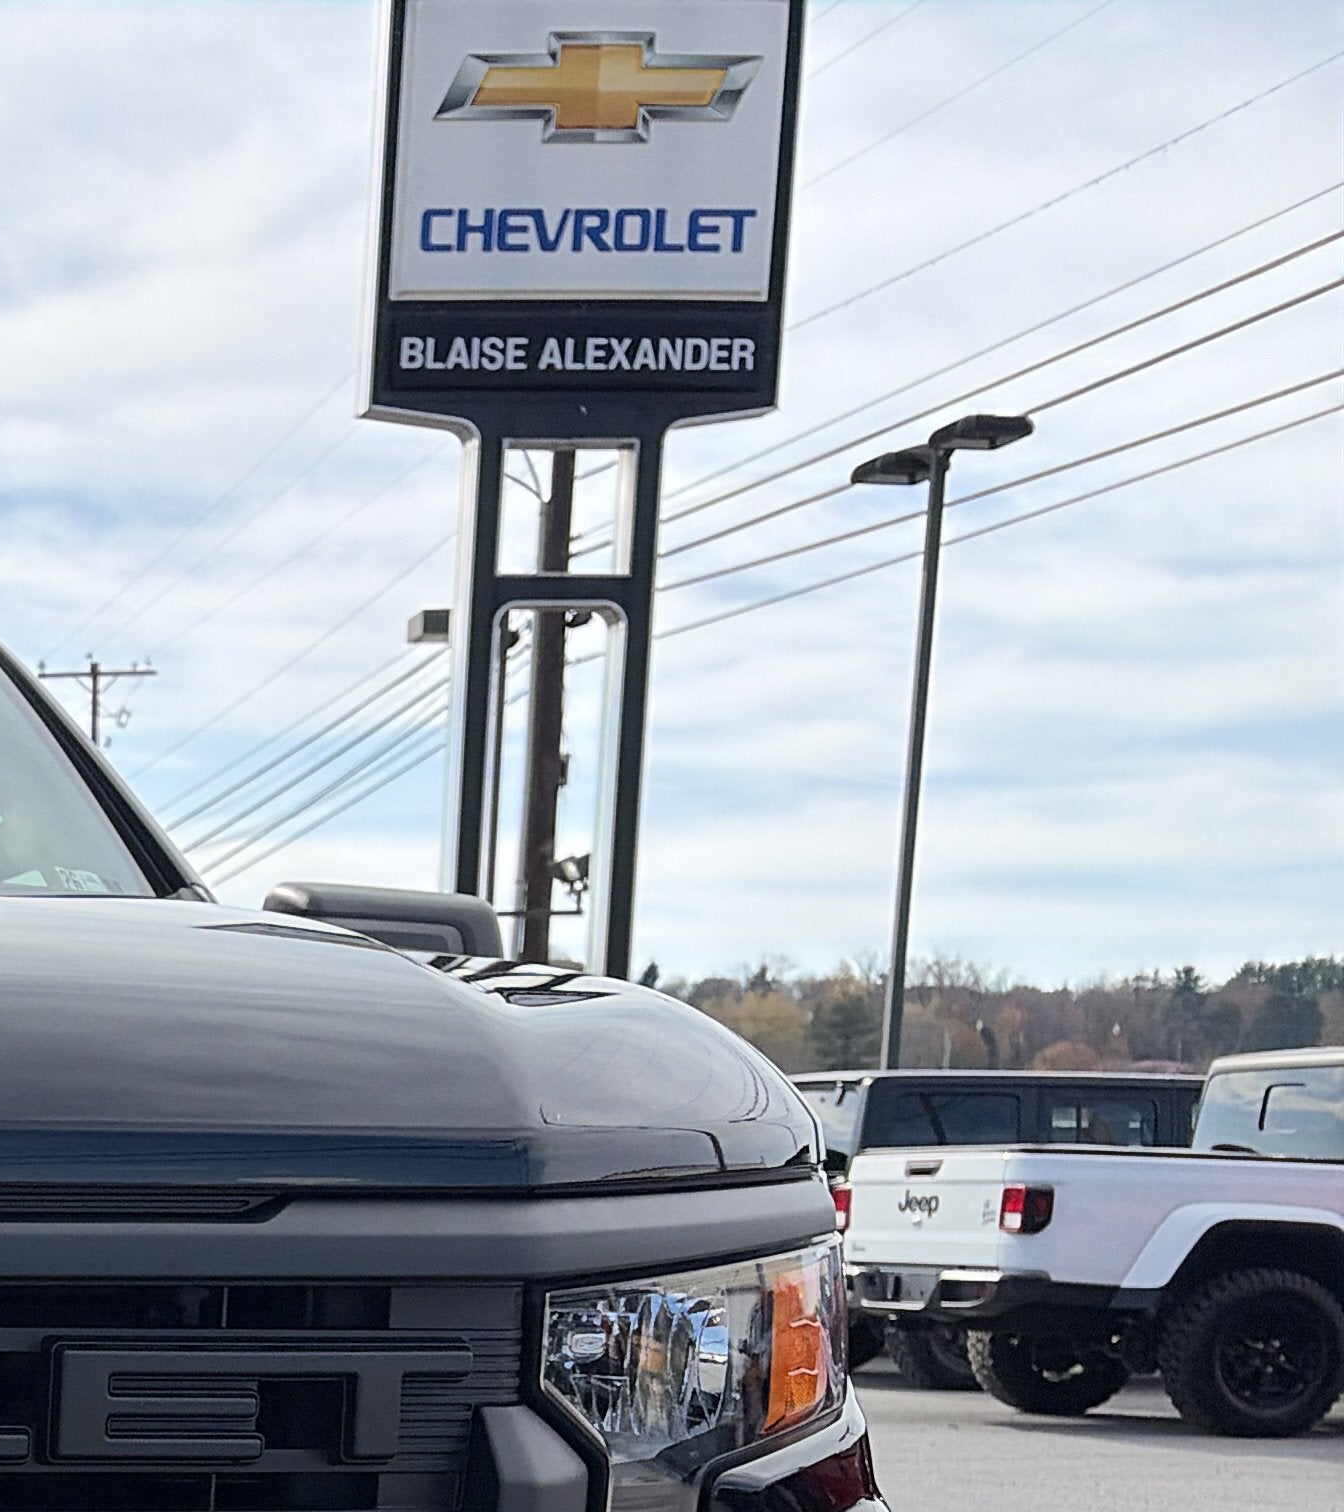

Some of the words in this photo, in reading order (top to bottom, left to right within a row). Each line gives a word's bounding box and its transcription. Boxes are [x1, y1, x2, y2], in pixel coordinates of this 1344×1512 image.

[419, 207, 758, 253] CHEVROLET
[399, 335, 528, 370] BLAISE
[538, 336, 756, 372] ALEXANDER
[898, 1189, 940, 1218] Jeep
